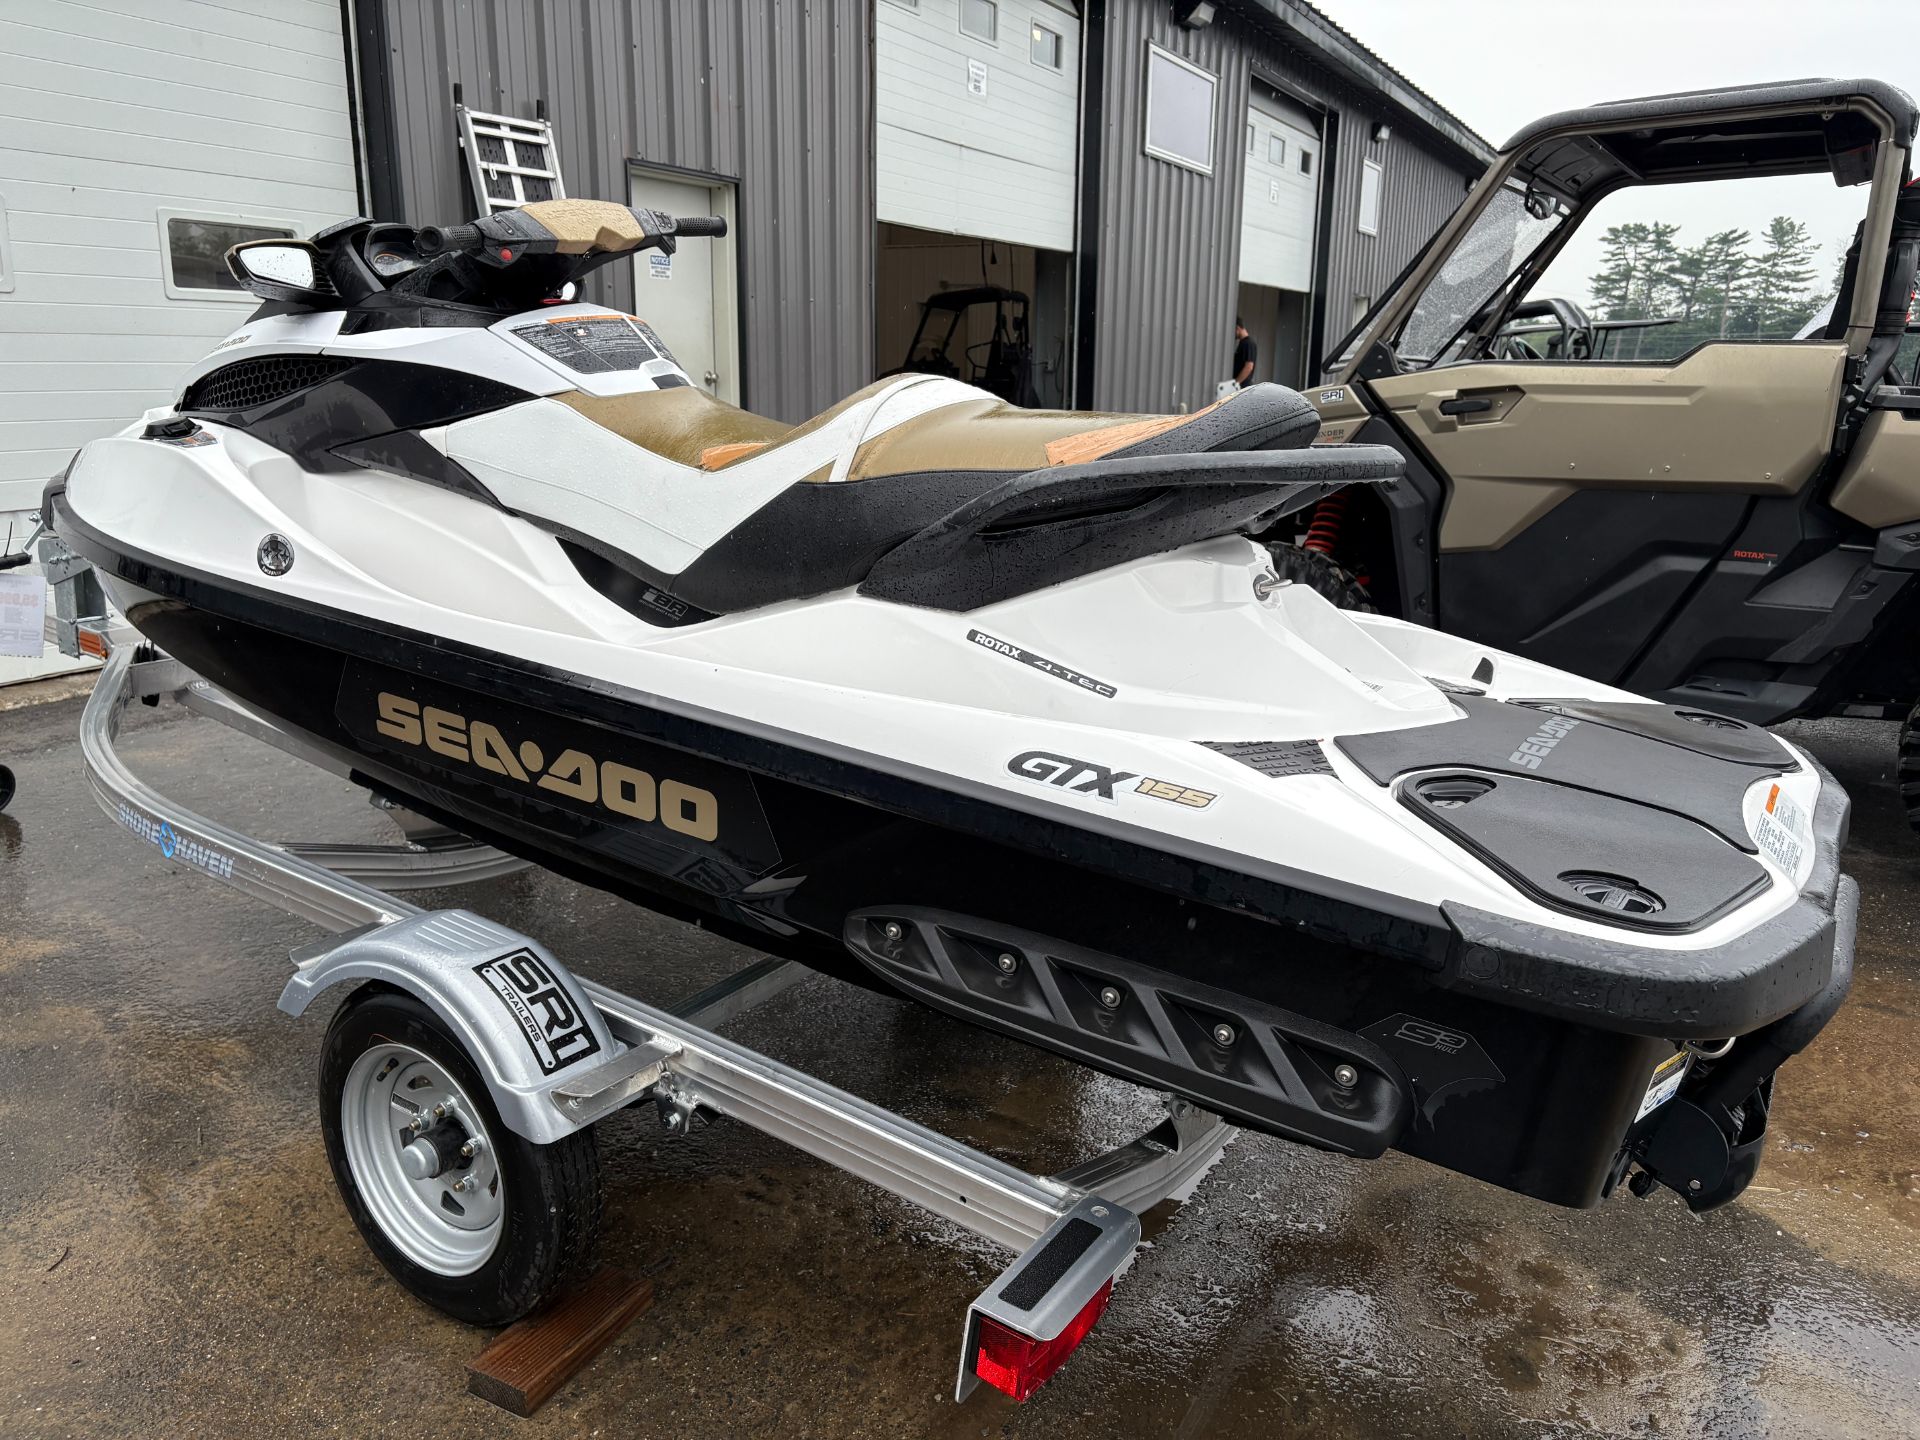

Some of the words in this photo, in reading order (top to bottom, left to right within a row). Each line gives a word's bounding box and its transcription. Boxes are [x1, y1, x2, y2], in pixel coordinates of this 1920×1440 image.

[651, 256, 670, 265] NOTICE
[1733, 550, 1765, 560] ROTAX
[975, 633, 1022, 660] ROTAX
[1033, 660, 1114, 696] 4-TEC
[1007, 750, 1140, 801] GTX
[1134, 777, 1218, 808] 155
[118, 802, 161, 846] SHORE
[174, 834, 234, 880] HAVEN
[497, 955, 591, 1061] SR1
[501, 984, 541, 1042] TRAILERS
[1394, 1021, 1467, 1049] S3
[1434, 1043, 1457, 1055] HULL
